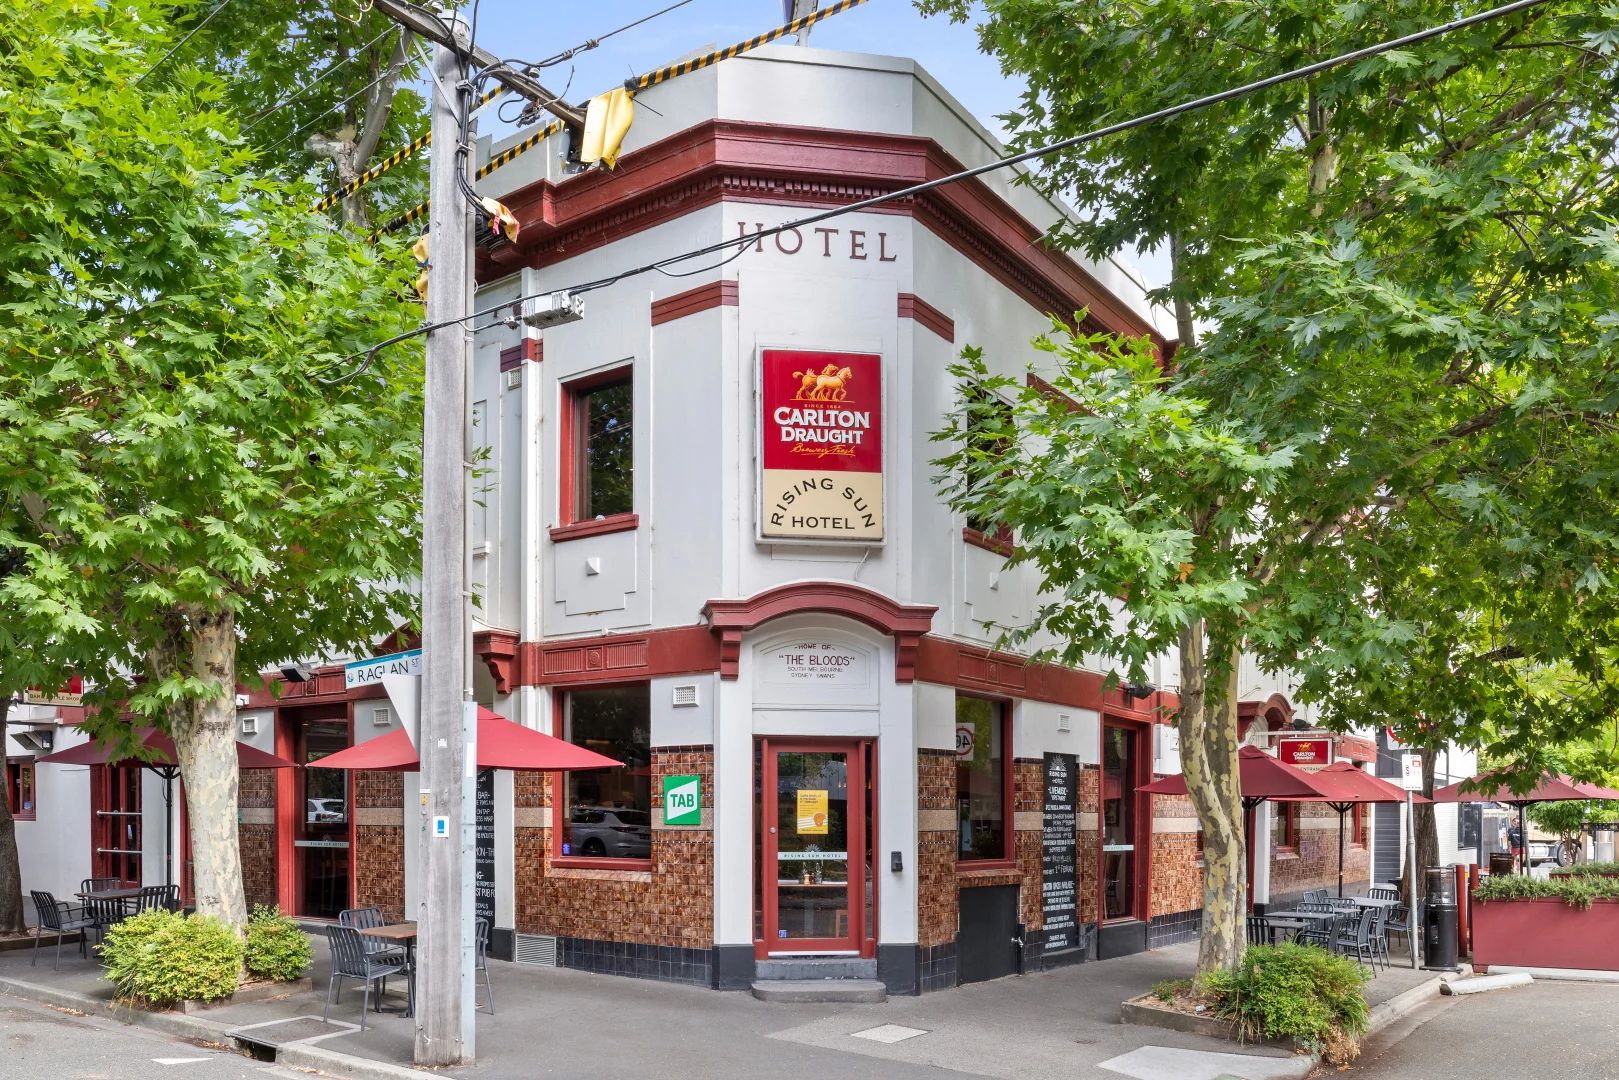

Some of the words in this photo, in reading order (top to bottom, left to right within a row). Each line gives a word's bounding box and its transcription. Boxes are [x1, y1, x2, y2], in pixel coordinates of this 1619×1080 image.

[738, 222, 897, 261] HOTEL
[774, 406, 871, 428] CARLTON
[781, 427, 864, 444] DRAUGHT
[790, 442, 829, 459] Brewery
[828, 444, 856, 455] Fresh
[771, 478, 834, 526] RISING
[842, 487, 876, 528] SUN
[792, 516, 856, 530] HOTEL
[411, 657, 420, 668] ST
[670, 793, 694, 807] TAB
